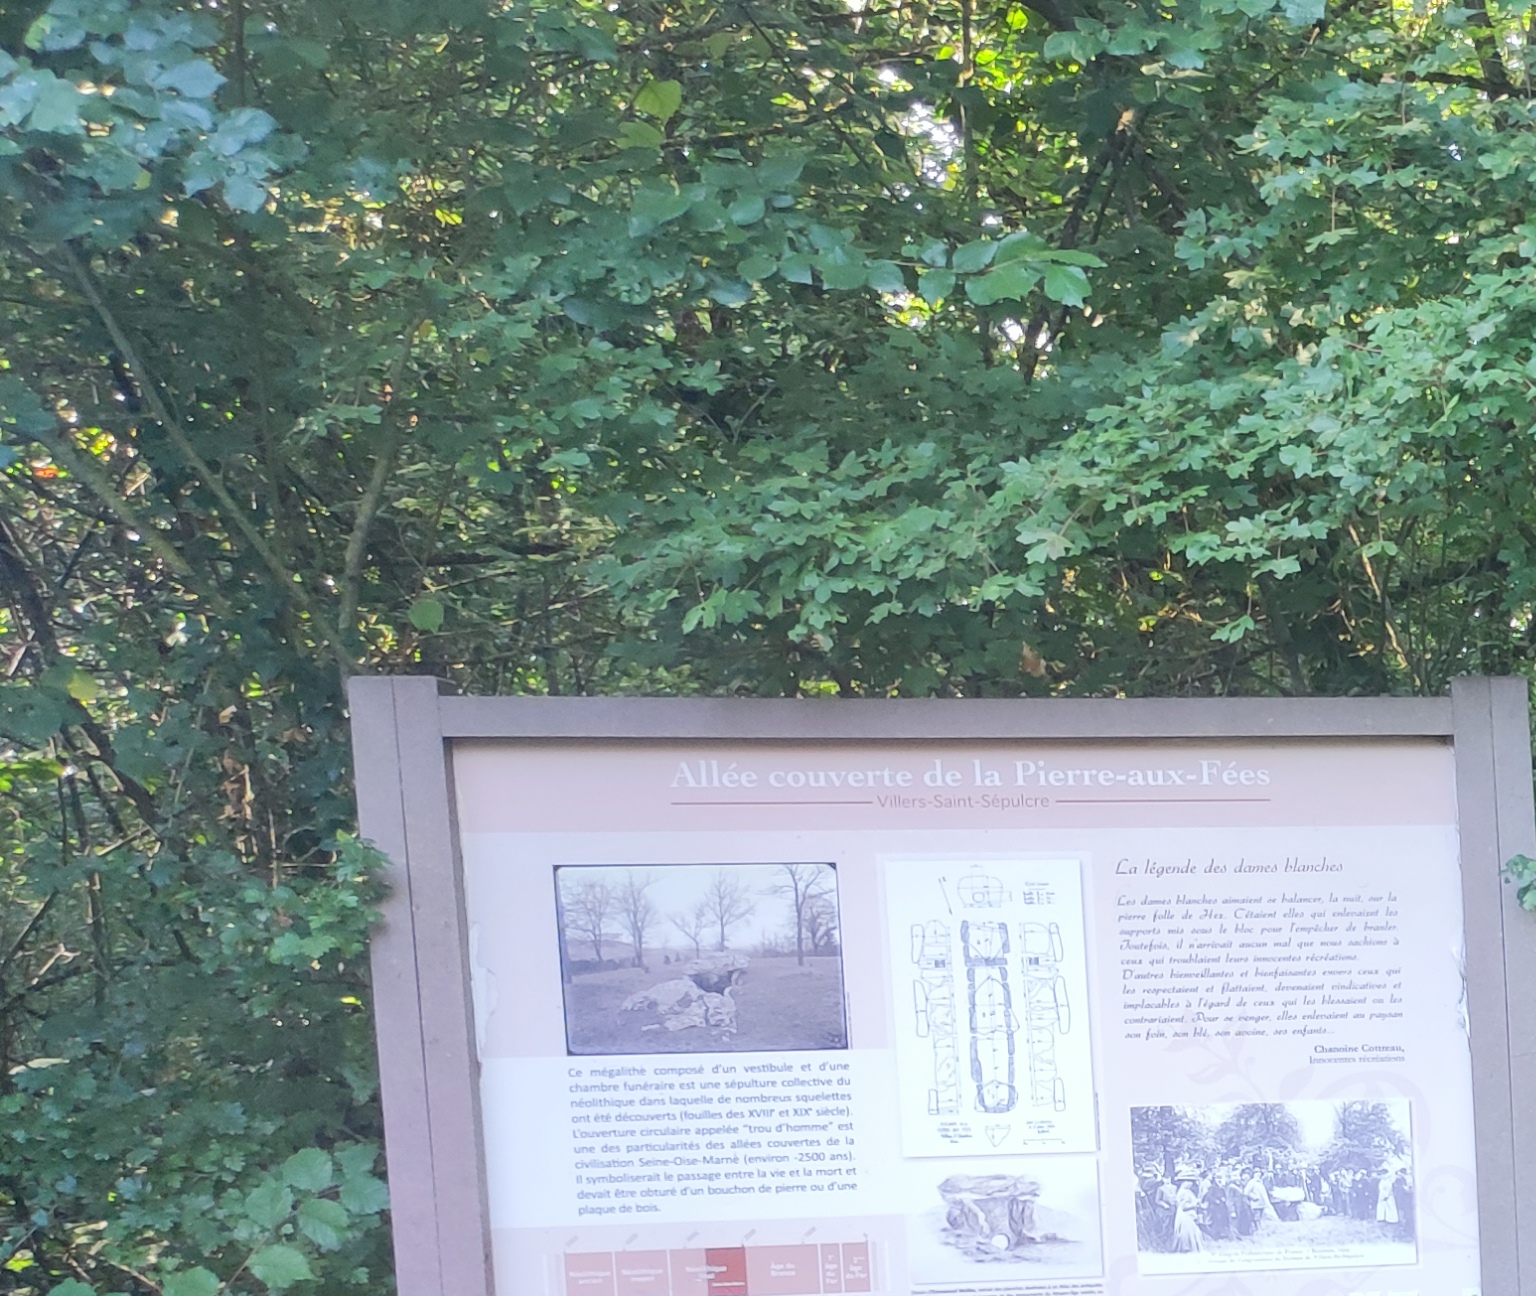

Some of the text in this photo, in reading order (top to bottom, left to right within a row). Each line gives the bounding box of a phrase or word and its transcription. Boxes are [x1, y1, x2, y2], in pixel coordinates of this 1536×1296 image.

[670, 759, 1270, 790] Allée couverte de la Pierre-aux-Fées
[877, 793, 1049, 811] Villers-Saint-Sépulcre
[1116, 856, 1342, 878] La légende des dames blanches
[1117, 895, 1135, 906] Les
[1140, 895, 1171, 906] dames
[1176, 894, 1217, 906] blanches
[1222, 896, 1262, 905] aimaient
[1329, 892, 1338, 902] la
[1387, 891, 1396, 901] la
[1118, 912, 1145, 922] pierre
[1153, 910, 1174, 922] folle
[1181, 909, 1192, 919] de
[1282, 907, 1304, 918] elles
[1310, 909, 1325, 919] qui
[1385, 906, 1397, 916] les
[1167, 926, 1184, 934] mis
[1219, 923, 1226, 933] le
[1234, 923, 1253, 933] bloc
[1261, 927, 1282, 935] pour
[1345, 921, 1356, 931] de
[1176, 939, 1182, 949] il
[1273, 937, 1290, 947] mal
[1297, 941, 1313, 949] que
[1393, 937, 1399, 945] à
[1149, 956, 1164, 966] qui
[1169, 953, 1220, 964] troublaient
[1225, 952, 1248, 962] leurs
[1254, 966, 1316, 979] bienfaisantes
[1385, 967, 1400, 976] qui
[1122, 984, 1135, 994] les
[1142, 985, 1198, 996] respectaient
[1274, 980, 1323, 991] devenaient
[1331, 979, 1386, 990] vindicatives
[1123, 997, 1179, 1011] implacables
[1185, 999, 1191, 1008] à
[1236, 996, 1246, 1006] de
[1282, 998, 1296, 1008] qui
[1303, 995, 1315, 1005] les
[1390, 993, 1402, 1003] les
[1191, 1011, 1218, 1022] Pour
[1276, 1010, 1297, 1020] elles
[1314, 1043, 1404, 1053] Chanoine Cottreau,
[568, 1061, 849, 1079] Ce mégalithe composé d'un vestibule et d'une
[569, 1076, 850, 1092] chambre funéraire est une sépulture collective du
[570, 1091, 851, 1109] néolithique dans laquelle de nombreux squelettes
[571, 1114, 590, 1123] ont
[593, 1113, 611, 1122] été
[615, 1111, 676, 1121] découverts
[680, 1109, 722, 1121] (fouilles
[726, 1109, 745, 1118] des
[778, 1109, 789, 1117] et
[816, 1106, 852, 1117] siècle).
[573, 1127, 636, 1138] L'ouverture
[640, 1126, 691, 1136] circulaire
[694, 1124, 739, 1136] appelée
[837, 1122, 853, 1130] est
[601, 1143, 620, 1152] des
[626, 1140, 700, 1153] particularités
[705, 1140, 724, 1149] des
[730, 1138, 761, 1149] allées
[767, 1138, 821, 1147] couvertes
[826, 1136, 840, 1145] de
[845, 1135, 854, 1145] la
[574, 1158, 634, 1169] civilisation
[744, 1153, 789, 1165] (environ
[794, 1152, 825, 1162] -2500
[829, 1150, 855, 1162] ans).
[576, 1167, 856, 1185] Il symboliserait le passage entre la vie et la mort et
[576, 1189, 610, 1199] devait
[614, 1188, 636, 1198] être
[639, 1187, 676, 1197] obturé
[680, 1186, 703, 1195] d'un
[707, 1184, 755, 1195] bouchon
[758, 1183, 771, 1193] de
[775, 1182, 807, 1194] pierre
[827, 1180, 857, 1190] d'une
[578, 1202, 661, 1216] plaque de bois.
